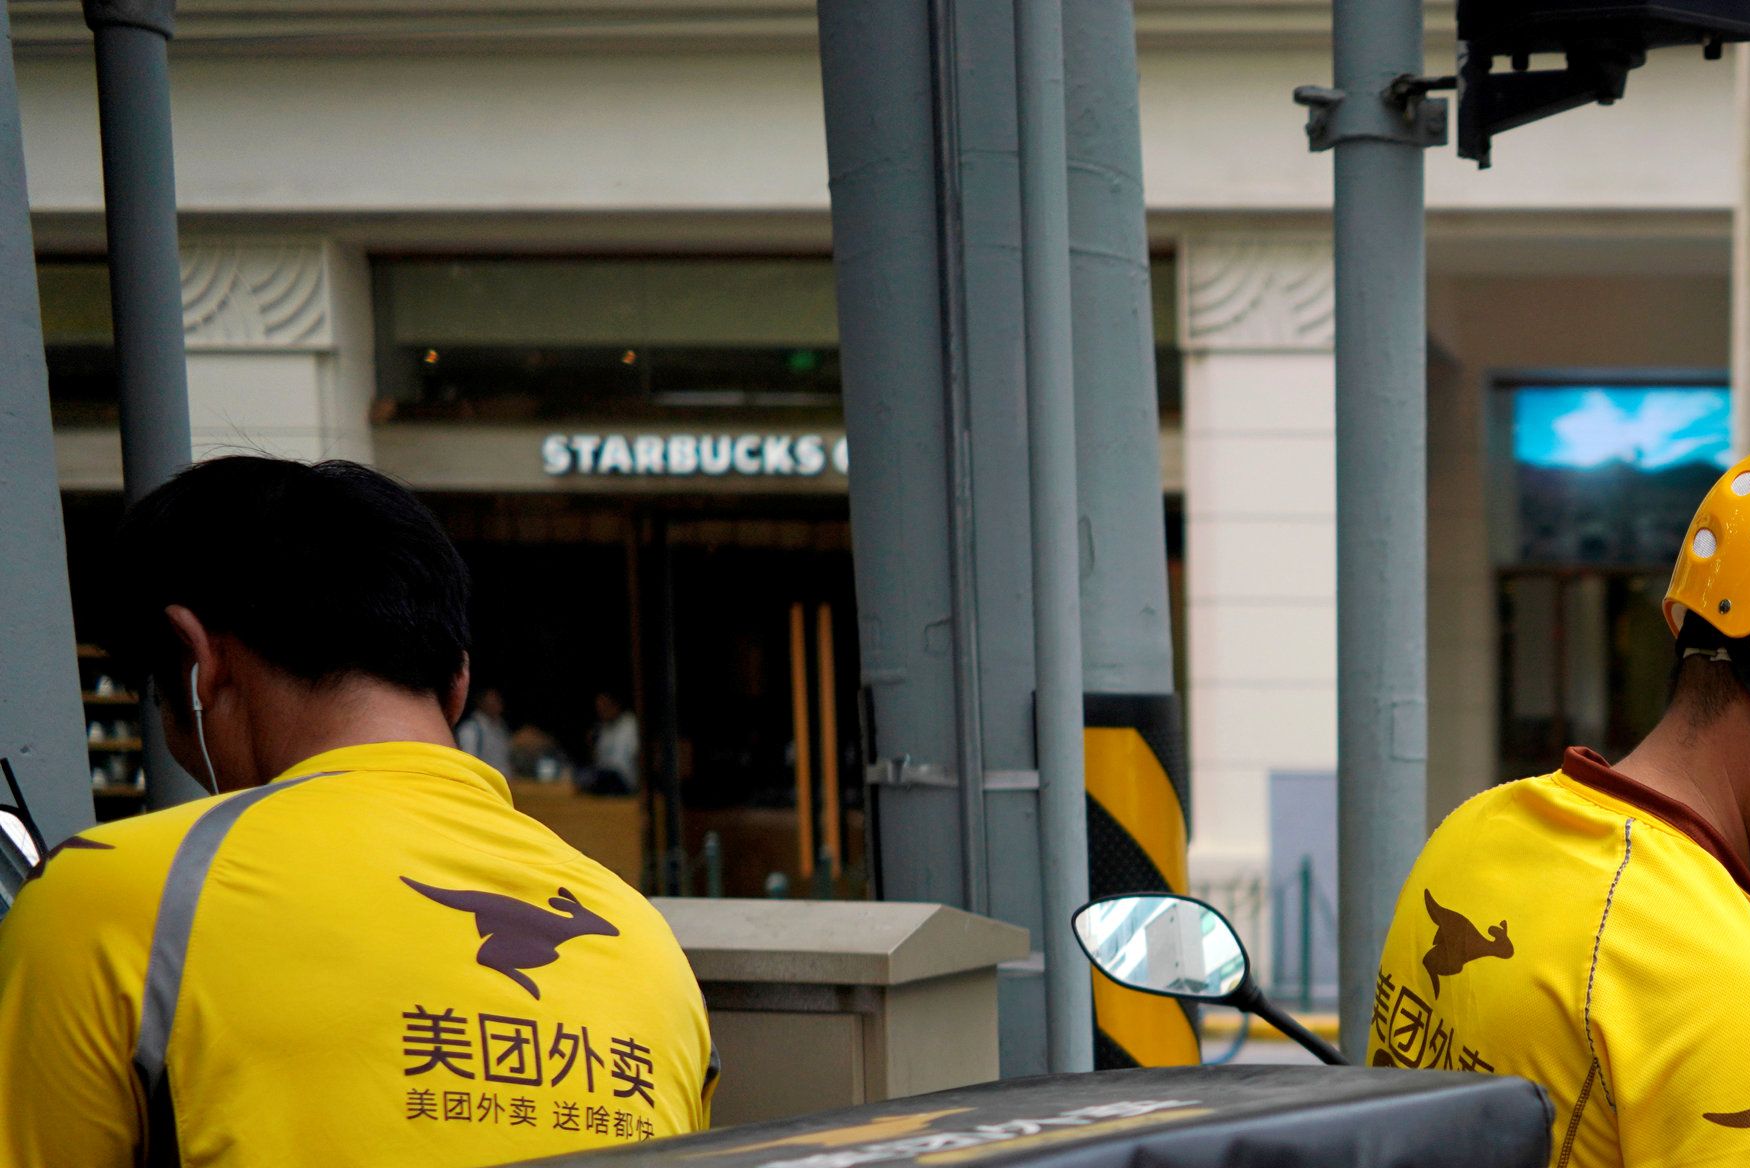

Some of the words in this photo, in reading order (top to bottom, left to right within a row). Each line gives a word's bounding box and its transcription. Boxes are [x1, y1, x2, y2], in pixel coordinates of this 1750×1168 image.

[541, 433, 827, 476] STARBUCKS
[402, 1004, 656, 1109] 美团外卖
[405, 1088, 537, 1127] 美团外卖
[552, 1100, 656, 1142] 送啥都快
